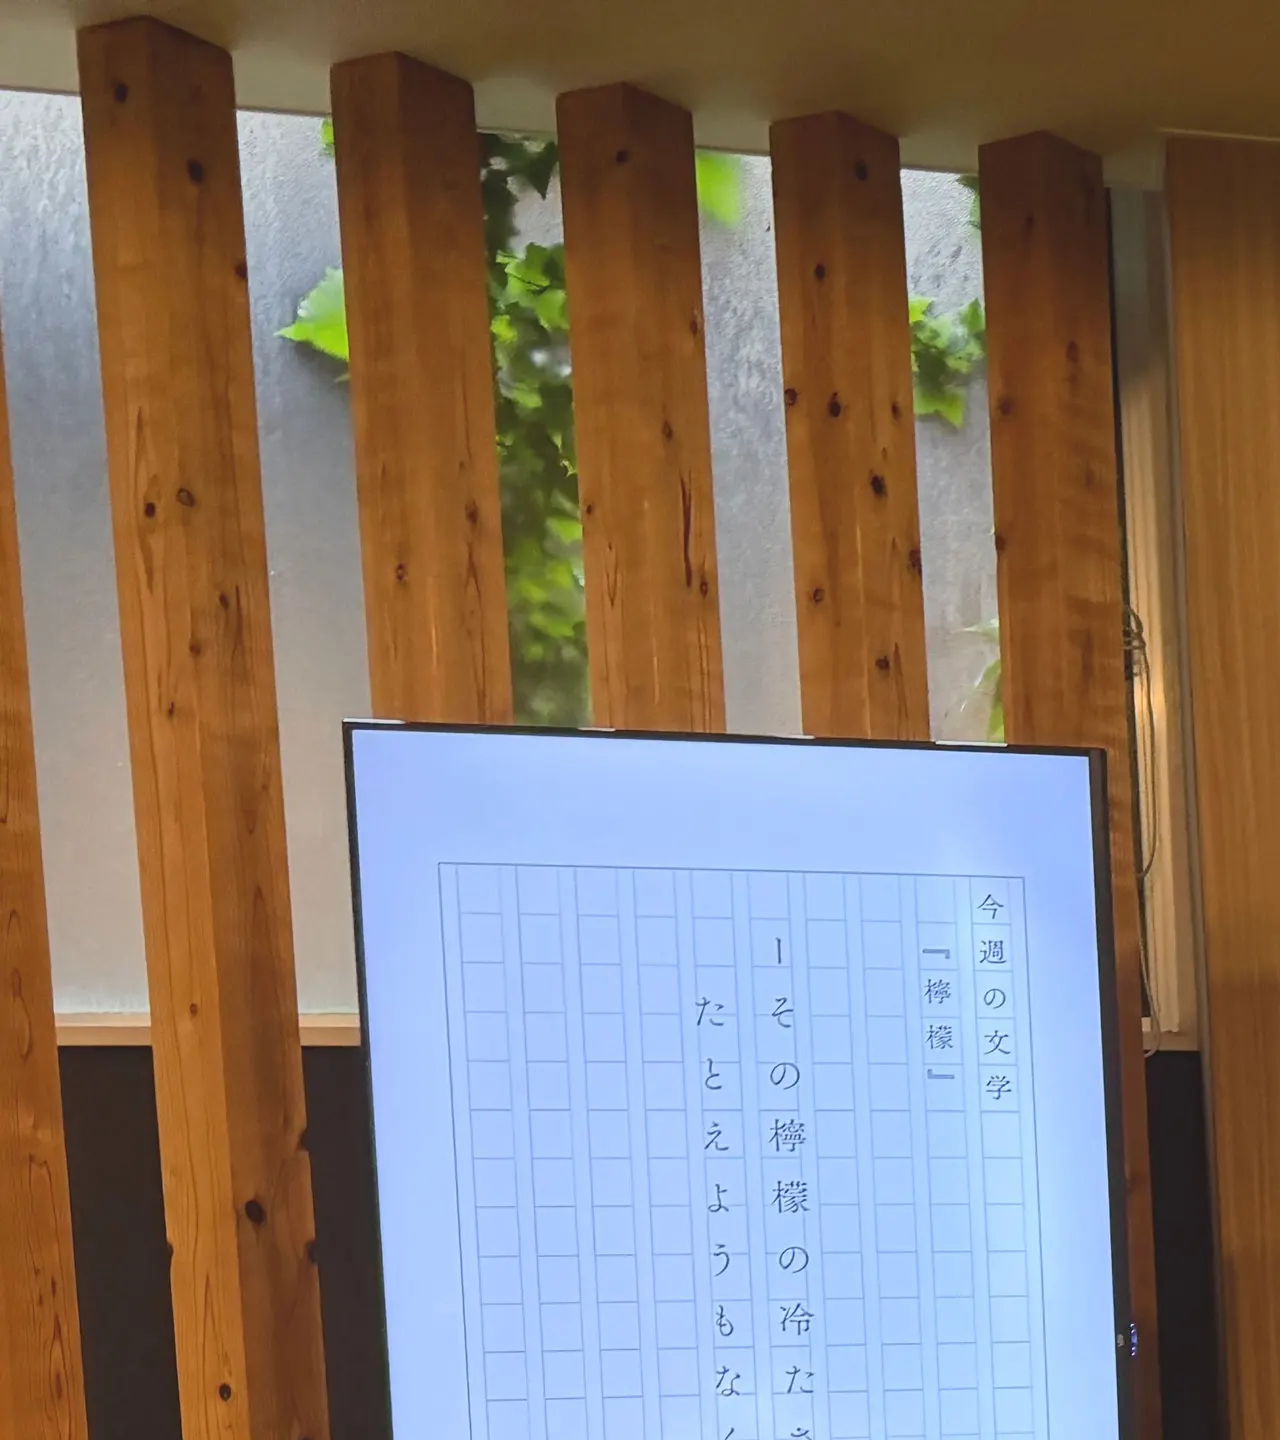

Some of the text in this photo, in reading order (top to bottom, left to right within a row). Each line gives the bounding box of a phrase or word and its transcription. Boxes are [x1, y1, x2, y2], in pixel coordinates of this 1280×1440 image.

[922, 947, 956, 1082] 『檸檬』
[976, 892, 1012, 1101] 今週の文学
